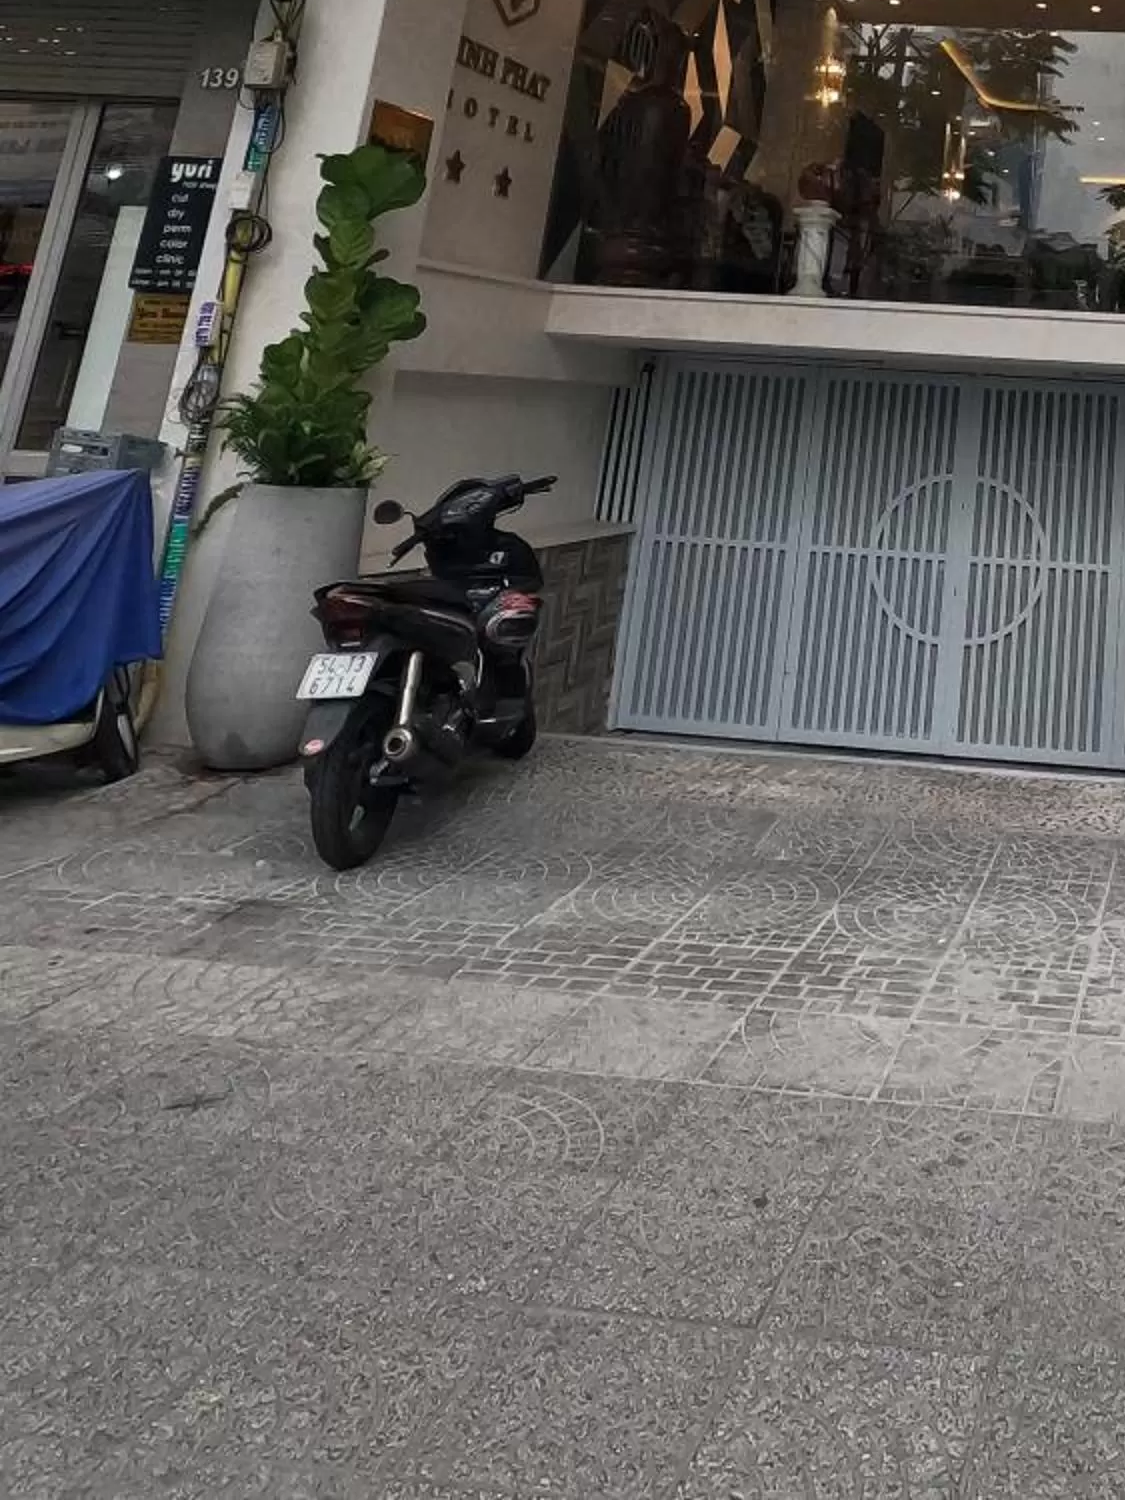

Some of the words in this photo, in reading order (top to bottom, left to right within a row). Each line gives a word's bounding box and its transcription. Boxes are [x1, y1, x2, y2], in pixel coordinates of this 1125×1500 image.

[200, 67, 240, 89] 139
[456, 35, 499, 79] INH
[500, 56, 552, 102] PHAT
[169, 159, 214, 183] yuri
